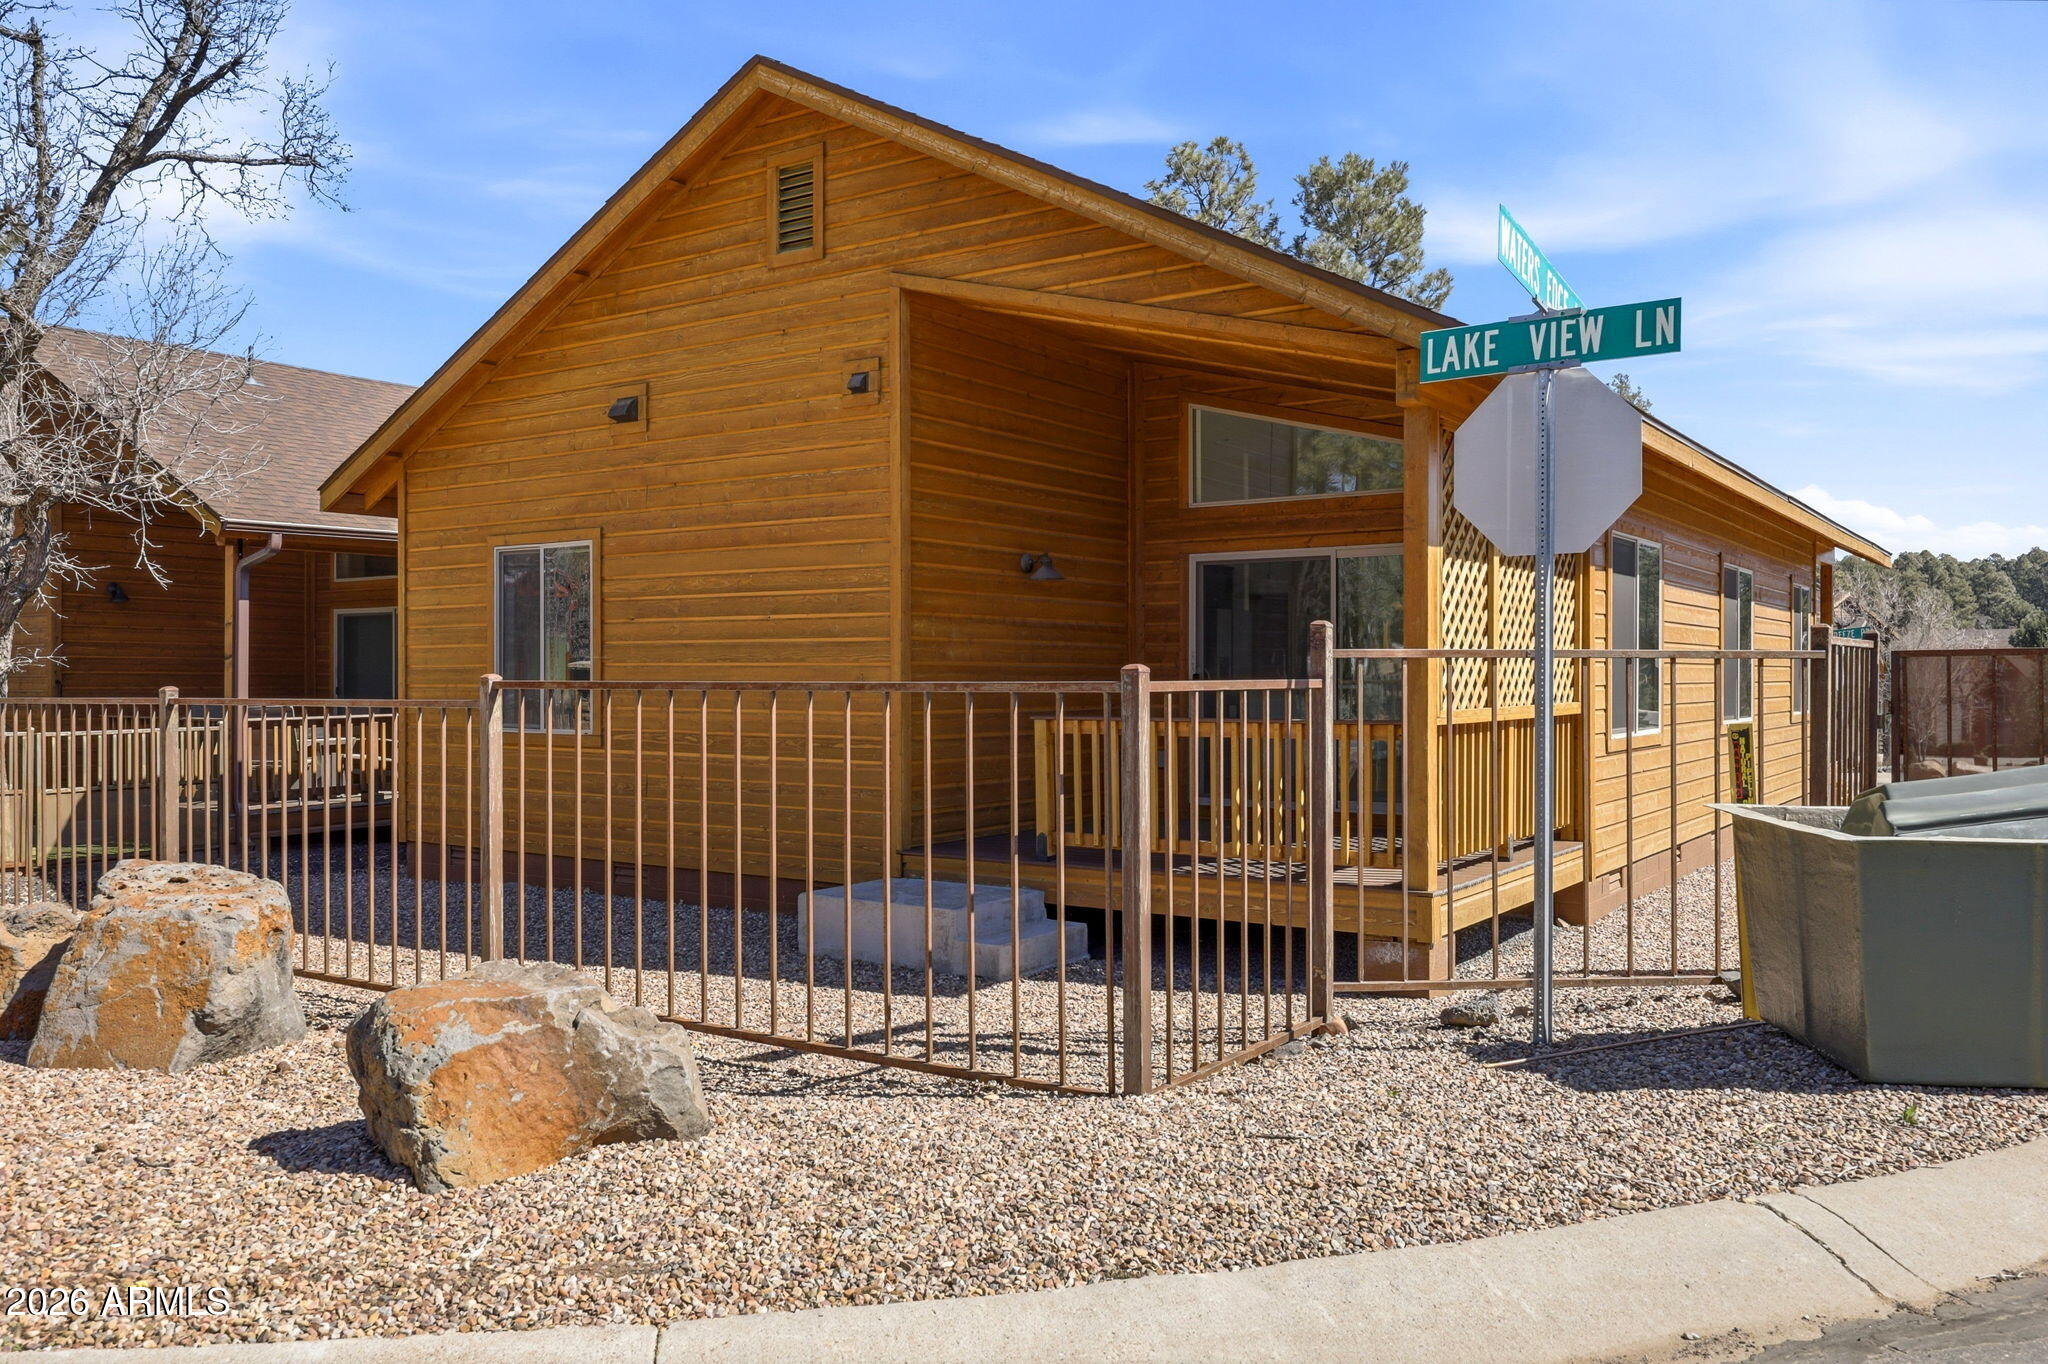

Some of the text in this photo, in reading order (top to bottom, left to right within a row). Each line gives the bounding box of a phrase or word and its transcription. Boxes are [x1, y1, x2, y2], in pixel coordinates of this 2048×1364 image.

[1501, 215, 1541, 295] WATERS
[1427, 305, 1675, 374] LAKE VIEW LN
